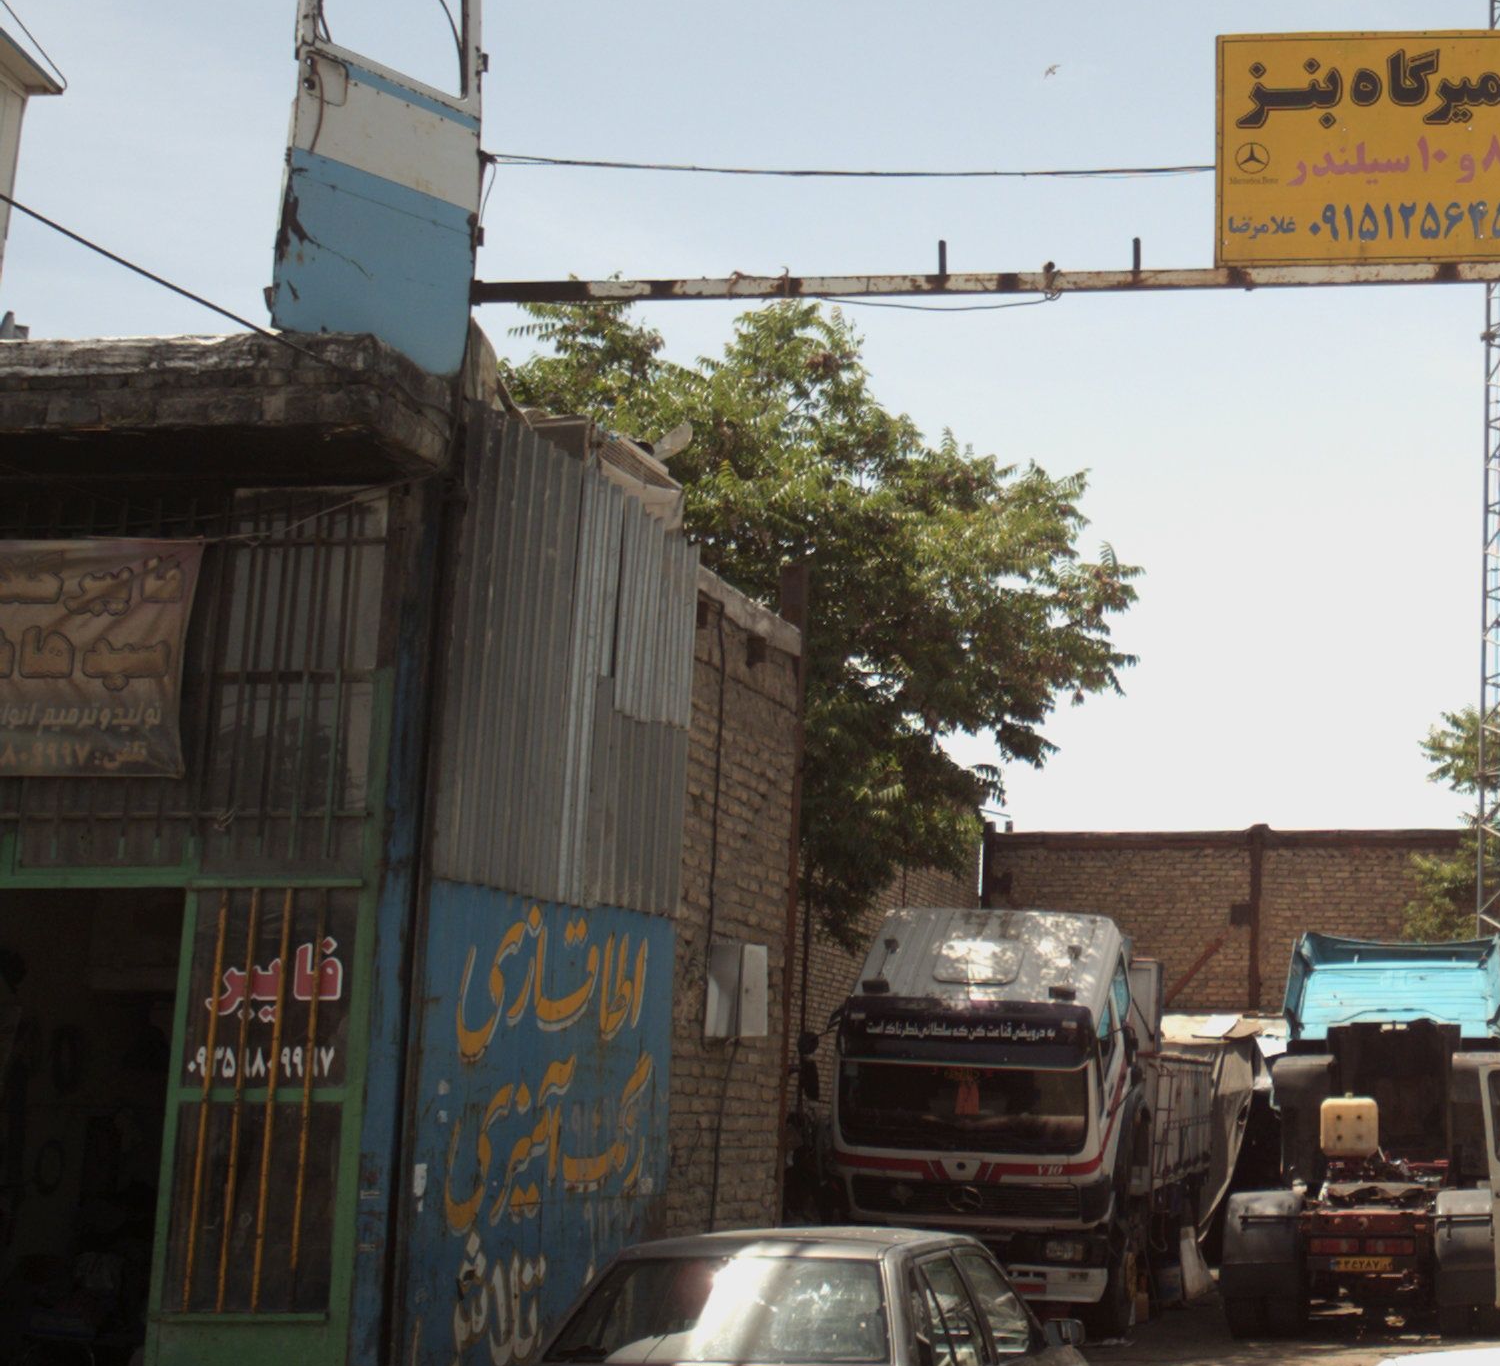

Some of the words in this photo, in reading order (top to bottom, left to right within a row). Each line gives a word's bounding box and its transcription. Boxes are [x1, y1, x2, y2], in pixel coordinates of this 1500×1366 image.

[1236, 58, 1343, 128] بنز
[1287, 141, 1410, 186] سیلندر
[1456, 153, 1476, 184] و
[1227, 215, 1296, 240] غلامرضا
